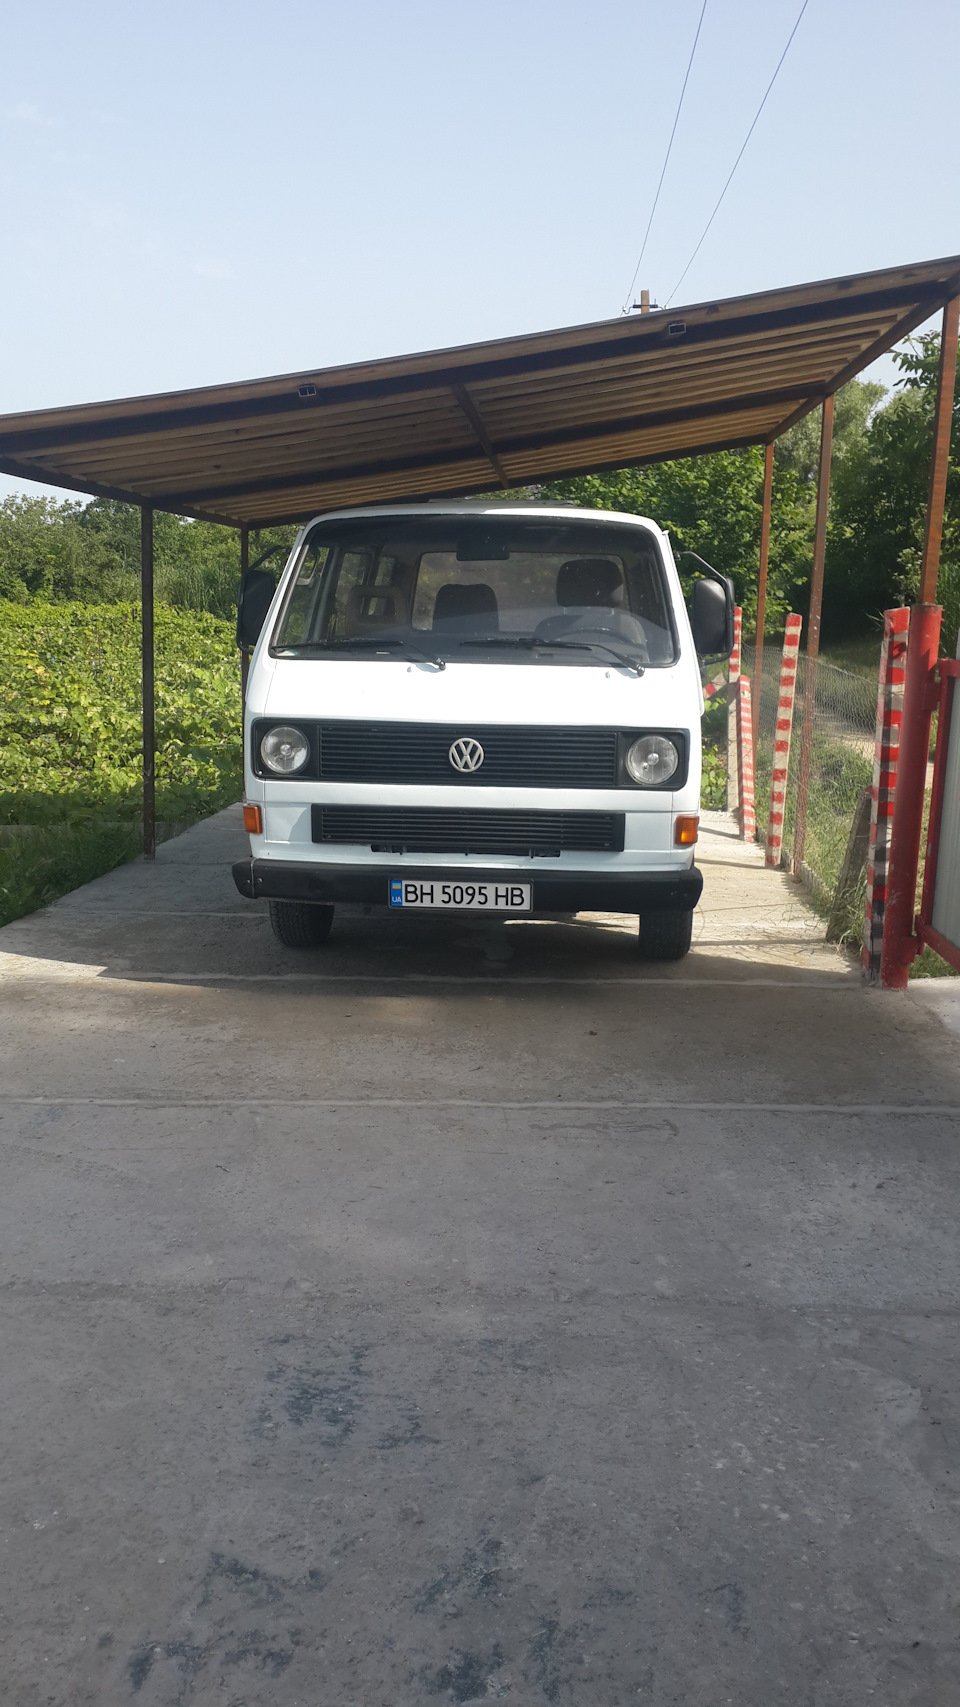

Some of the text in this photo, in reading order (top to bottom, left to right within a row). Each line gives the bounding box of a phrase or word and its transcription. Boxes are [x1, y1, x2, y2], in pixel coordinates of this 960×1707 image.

[449, 738, 484, 772] VW
[404, 884, 524, 906] BH 5095 HB
